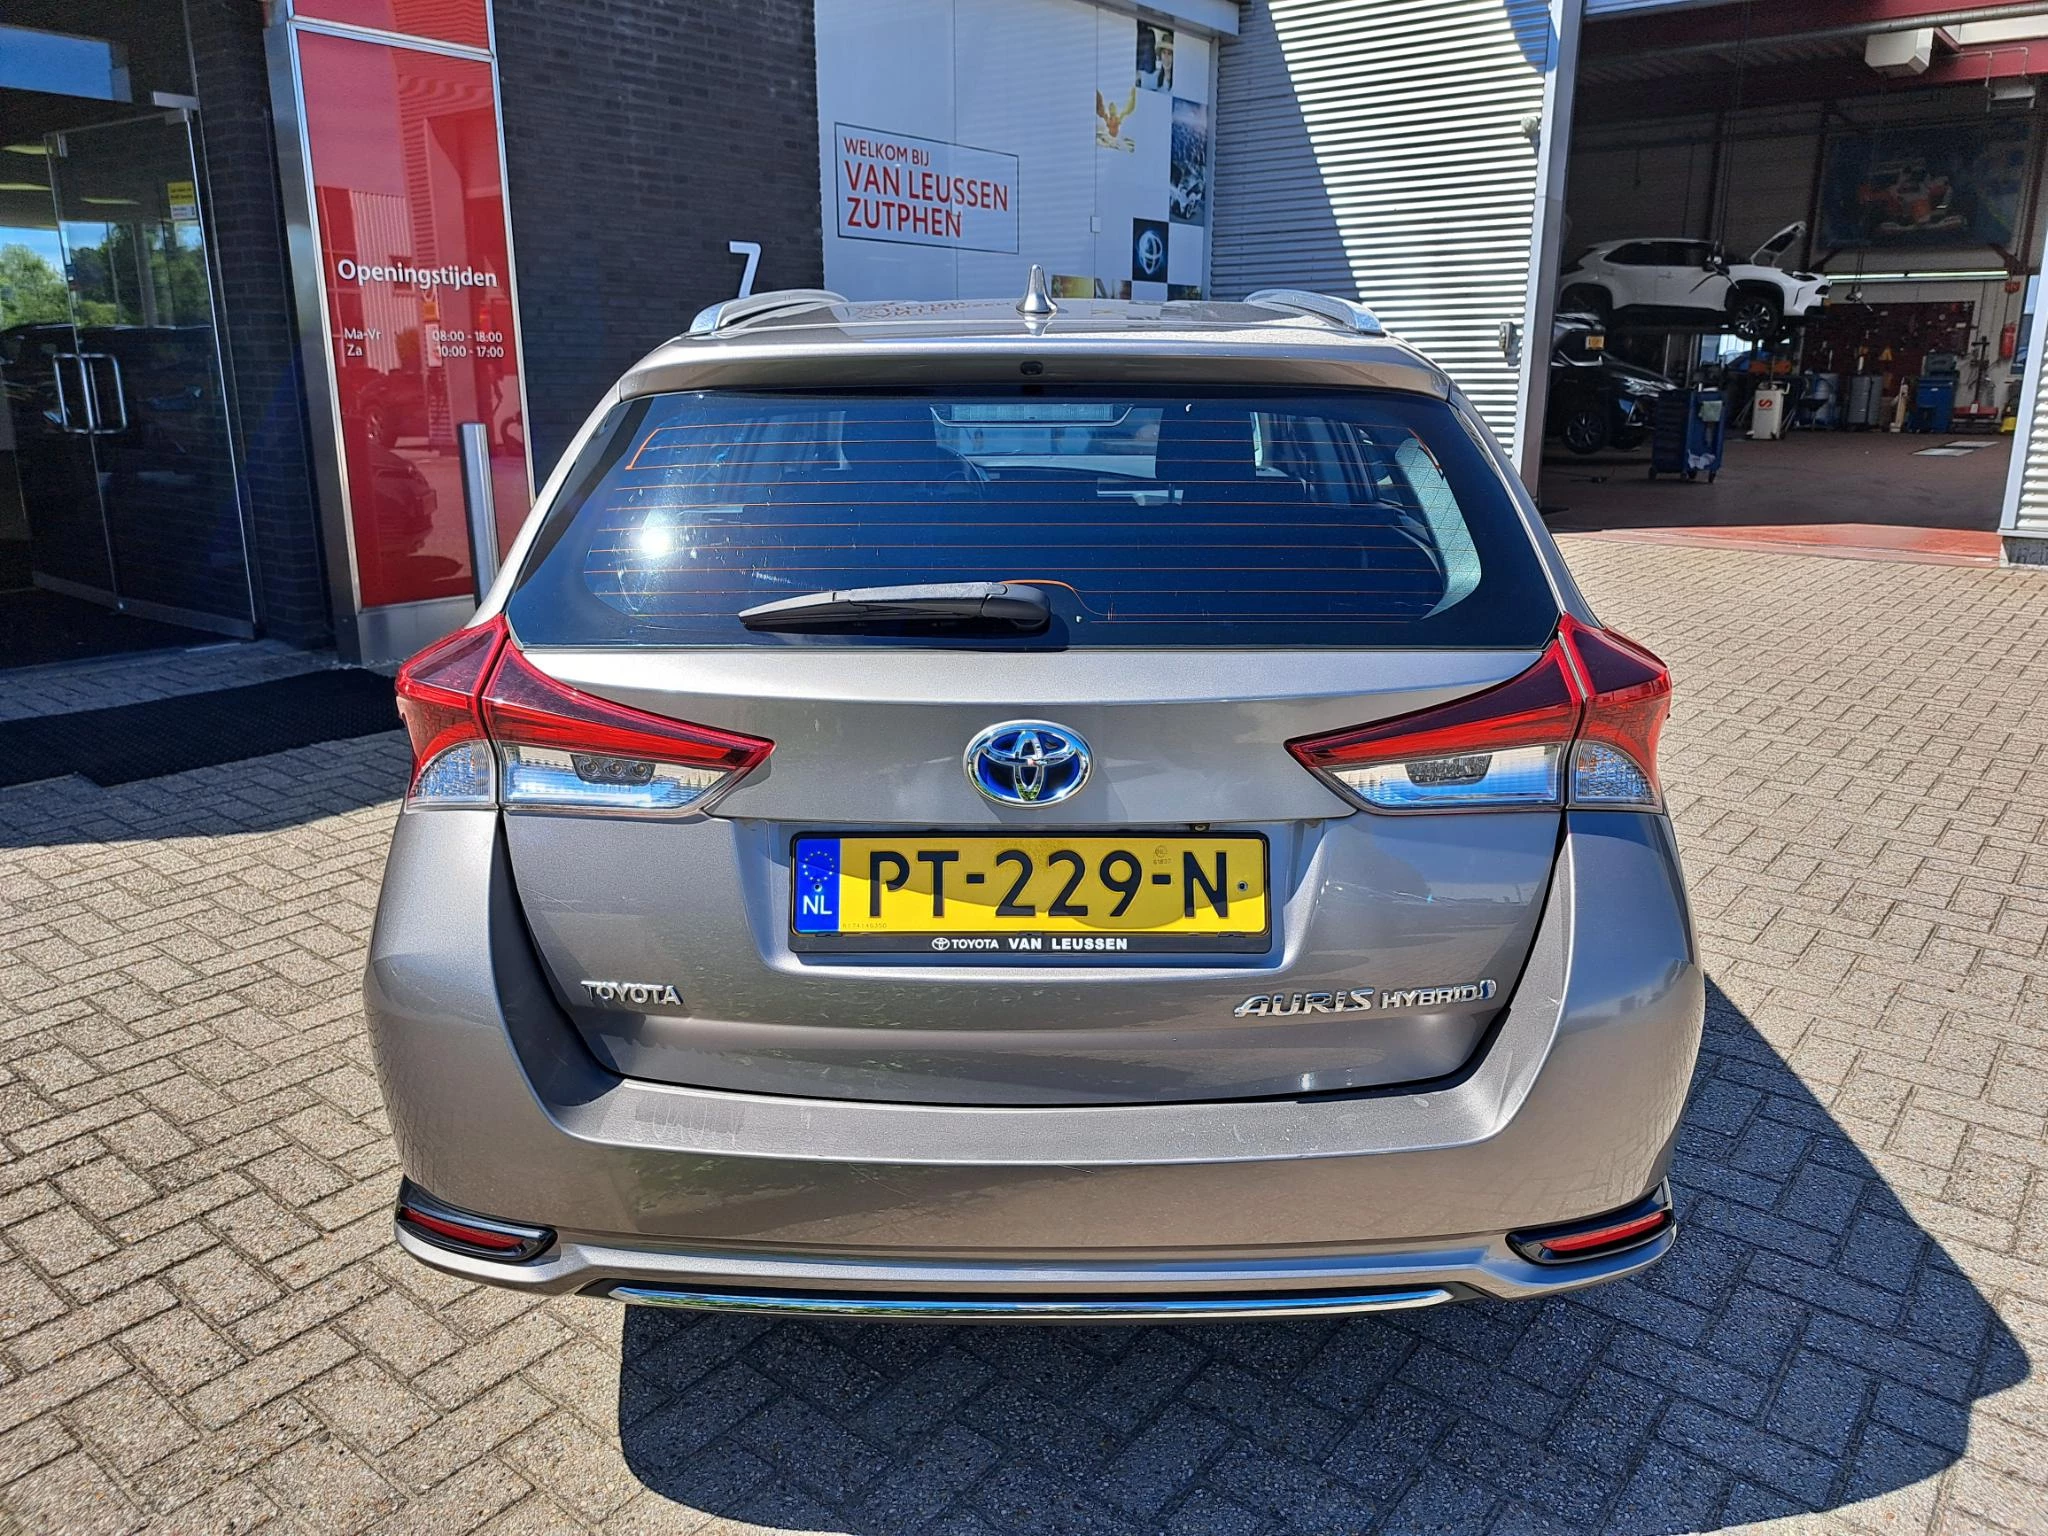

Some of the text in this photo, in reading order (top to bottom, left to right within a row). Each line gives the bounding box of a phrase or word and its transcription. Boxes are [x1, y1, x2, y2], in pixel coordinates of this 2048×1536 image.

[843, 137, 930, 167] WELKOM BIJ
[844, 160, 1009, 212] VAN LEUSSEN
[846, 196, 962, 238] ZUTPHEN
[337, 258, 498, 291] Openingstijden
[729, 240, 762, 299] 7
[344, 328, 382, 341] Ma-Vr
[431, 330, 465, 342] 08:00
[475, 331, 503, 343] 18:00
[346, 344, 363, 357] Za
[437, 345, 467, 357] 10:00
[476, 346, 505, 358] 17:00
[869, 849, 1229, 918] PT-229-N
[802, 894, 833, 916] NL
[951, 937, 1128, 951] TOYOTA VAN LEUSSEN
[580, 980, 684, 1006] TOYOTA
[1381, 983, 1482, 1010] HYBRID
